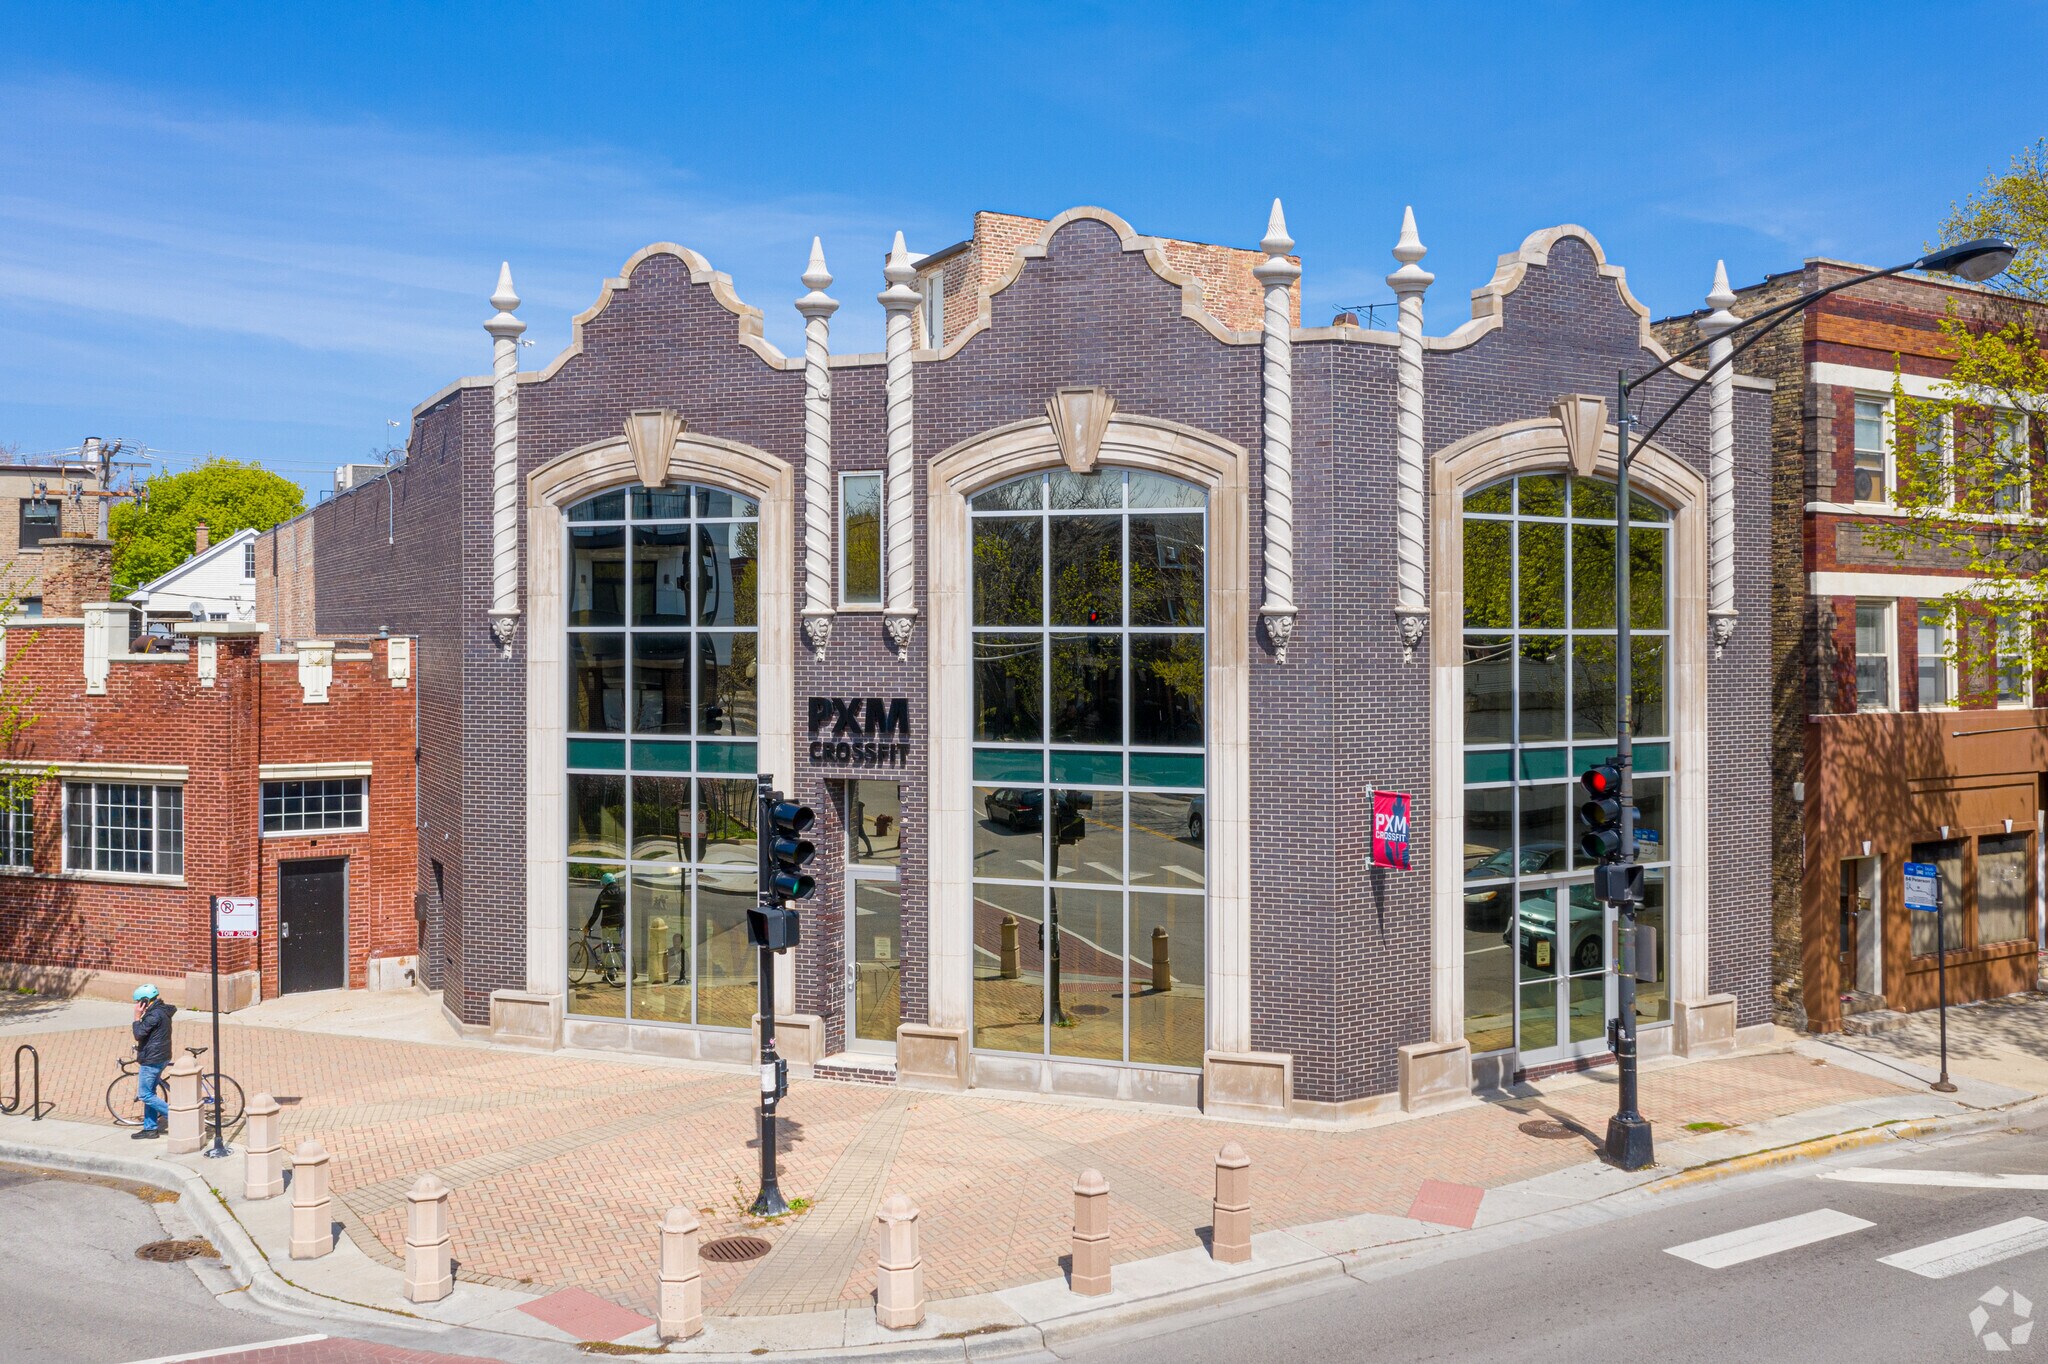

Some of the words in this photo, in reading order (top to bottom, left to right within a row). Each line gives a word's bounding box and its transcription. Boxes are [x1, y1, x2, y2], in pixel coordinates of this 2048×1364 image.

[808, 696, 910, 735] PXM
[808, 741, 911, 765] CROSSFIT
[1375, 813, 1407, 834] PXM
[1375, 830, 1407, 842] CROSSFIT
